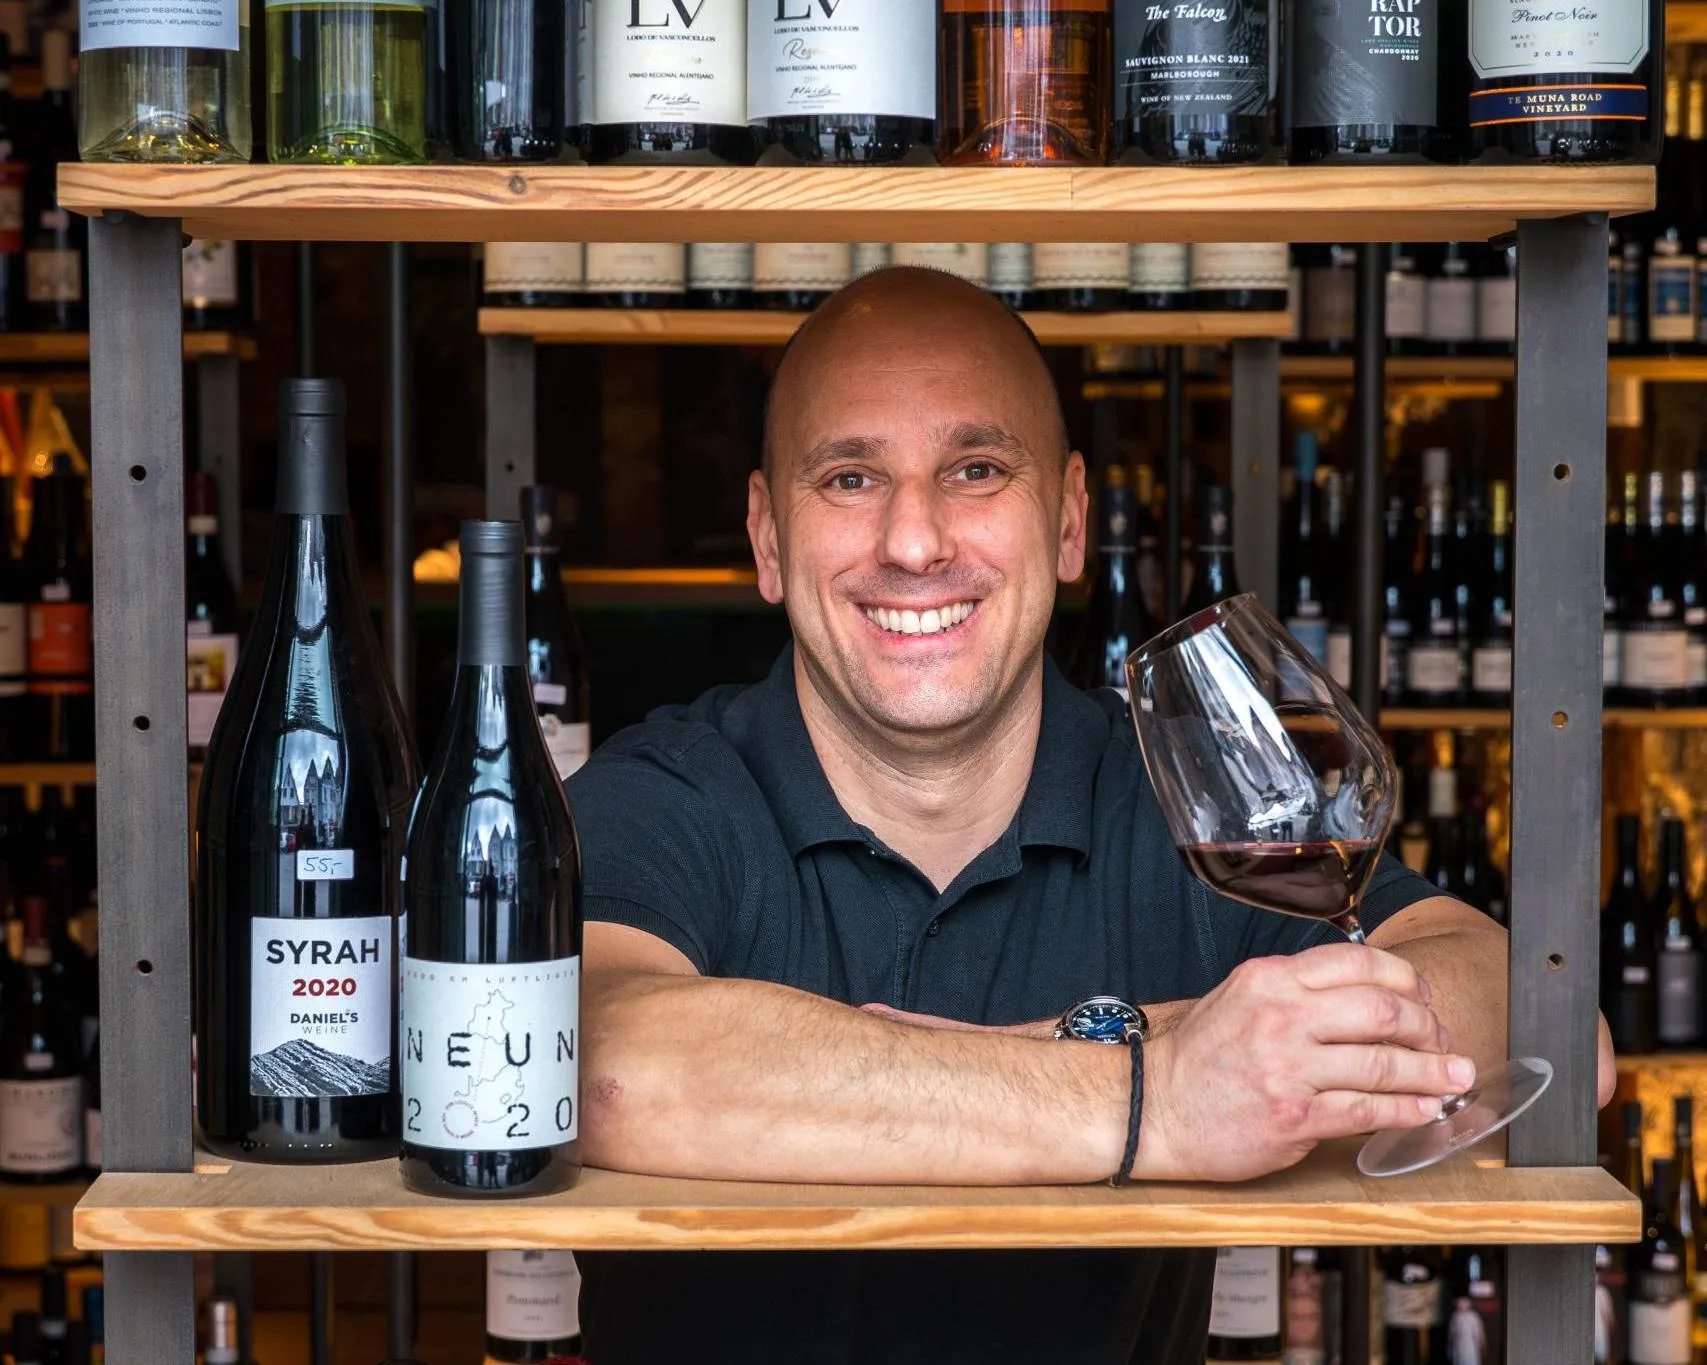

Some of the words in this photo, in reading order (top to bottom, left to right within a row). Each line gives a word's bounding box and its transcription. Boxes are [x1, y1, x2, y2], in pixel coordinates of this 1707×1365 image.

[1371, 0, 1421, 12] RAP
[1145, 5, 1170, 20] The
[1174, 3, 1227, 22] Falcon
[1511, 9, 1552, 23] Pinot
[1555, 6, 1598, 21] Noir
[1368, 16, 1422, 37] TOR
[1125, 55, 1183, 67] SAUVIGNON
[1186, 55, 1225, 64] BLANC
[1227, 55, 1249, 64] 2021
[1151, 71, 1220, 80] MARLBOROUGH
[1140, 95, 1159, 103] WINE
[1508, 97, 1521, 105] TE
[1527, 93, 1565, 103] MUNA
[1571, 93, 1602, 101] ROAD
[1522, 104, 1587, 113] VINEYARD
[266, 938, 379, 965] SYRAH
[292, 978, 357, 997] 2020
[302, 1025, 348, 1035] WEINE
